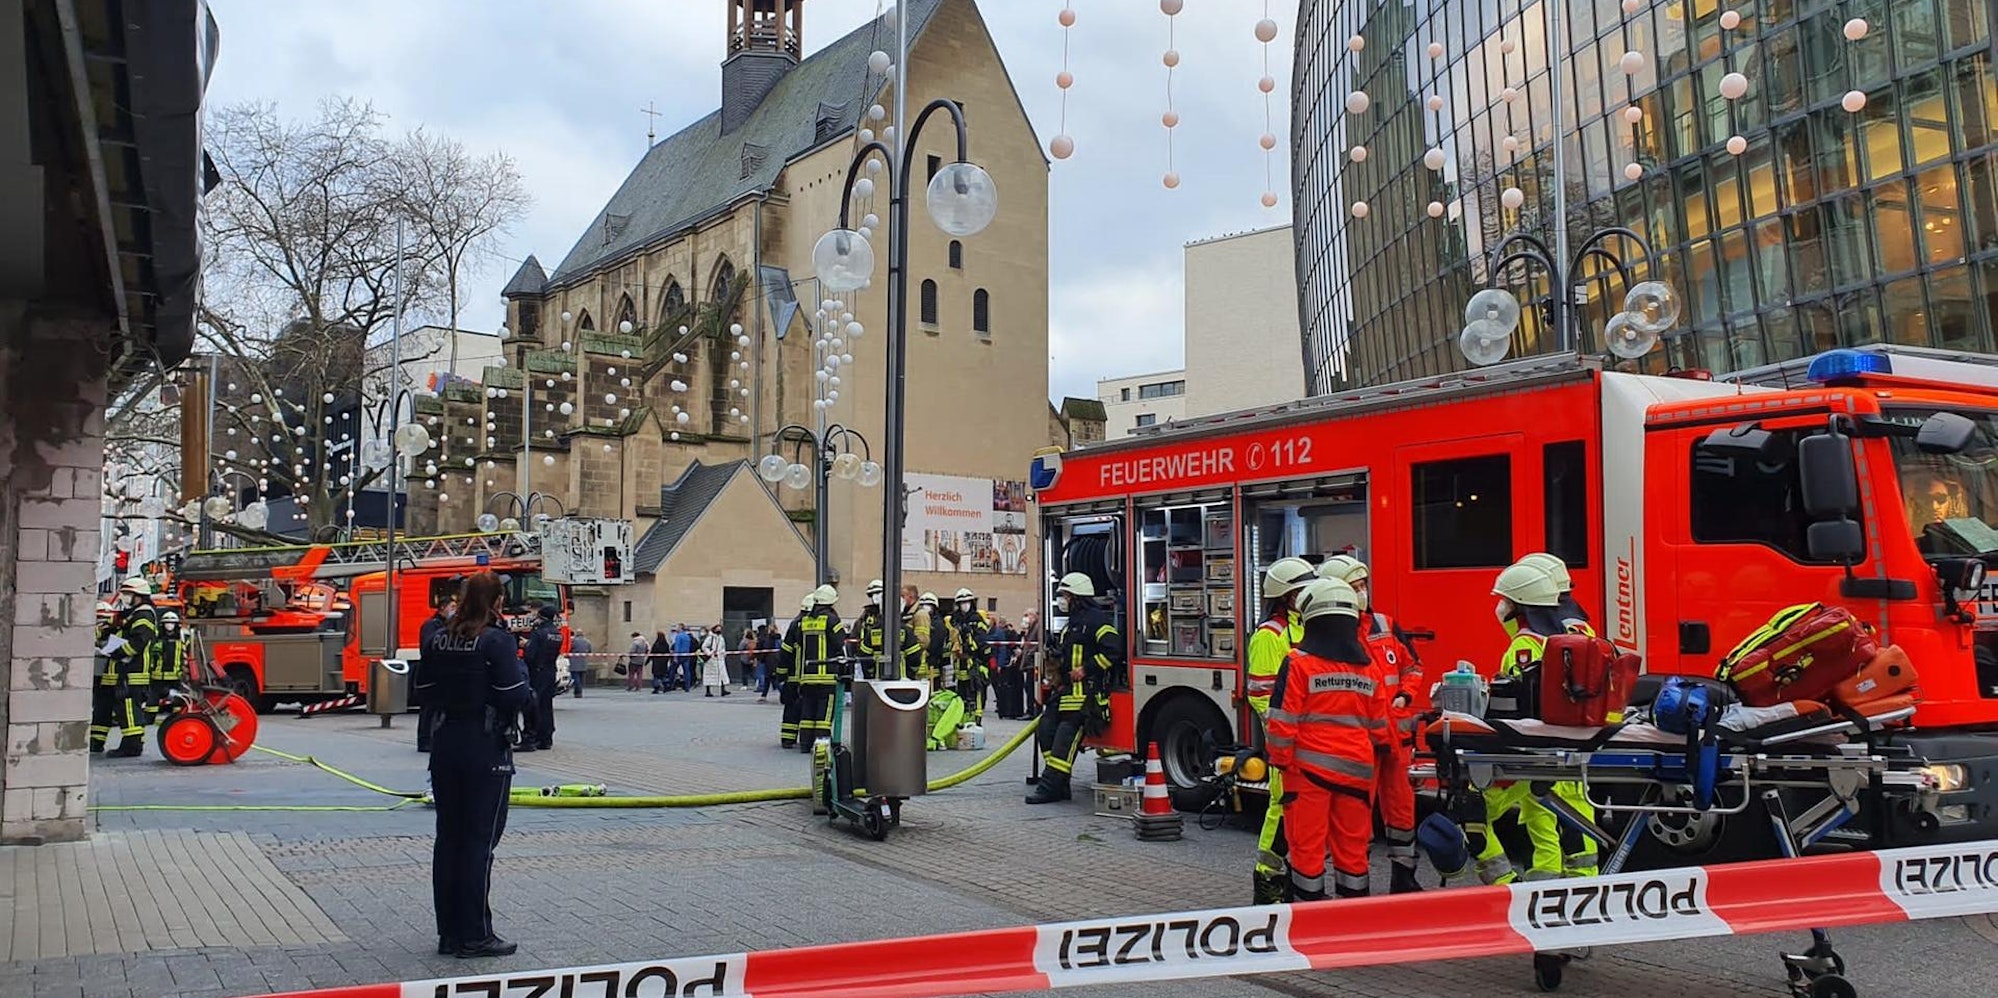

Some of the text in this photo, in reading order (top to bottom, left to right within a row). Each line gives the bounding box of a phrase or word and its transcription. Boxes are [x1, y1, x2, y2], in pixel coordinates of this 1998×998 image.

[1100, 436, 1312, 487] FEUERWEHR 112
[925, 490, 962, 502] Herzlich
[925, 505, 982, 518] Willkommen
[1613, 556, 1638, 651] Lentner
[432, 634, 480, 652] POLIZEI
[1894, 852, 1998, 896] OLIZEI
[1528, 877, 1701, 929] POLIZEI
[1059, 913, 1279, 969] POLIZEI
